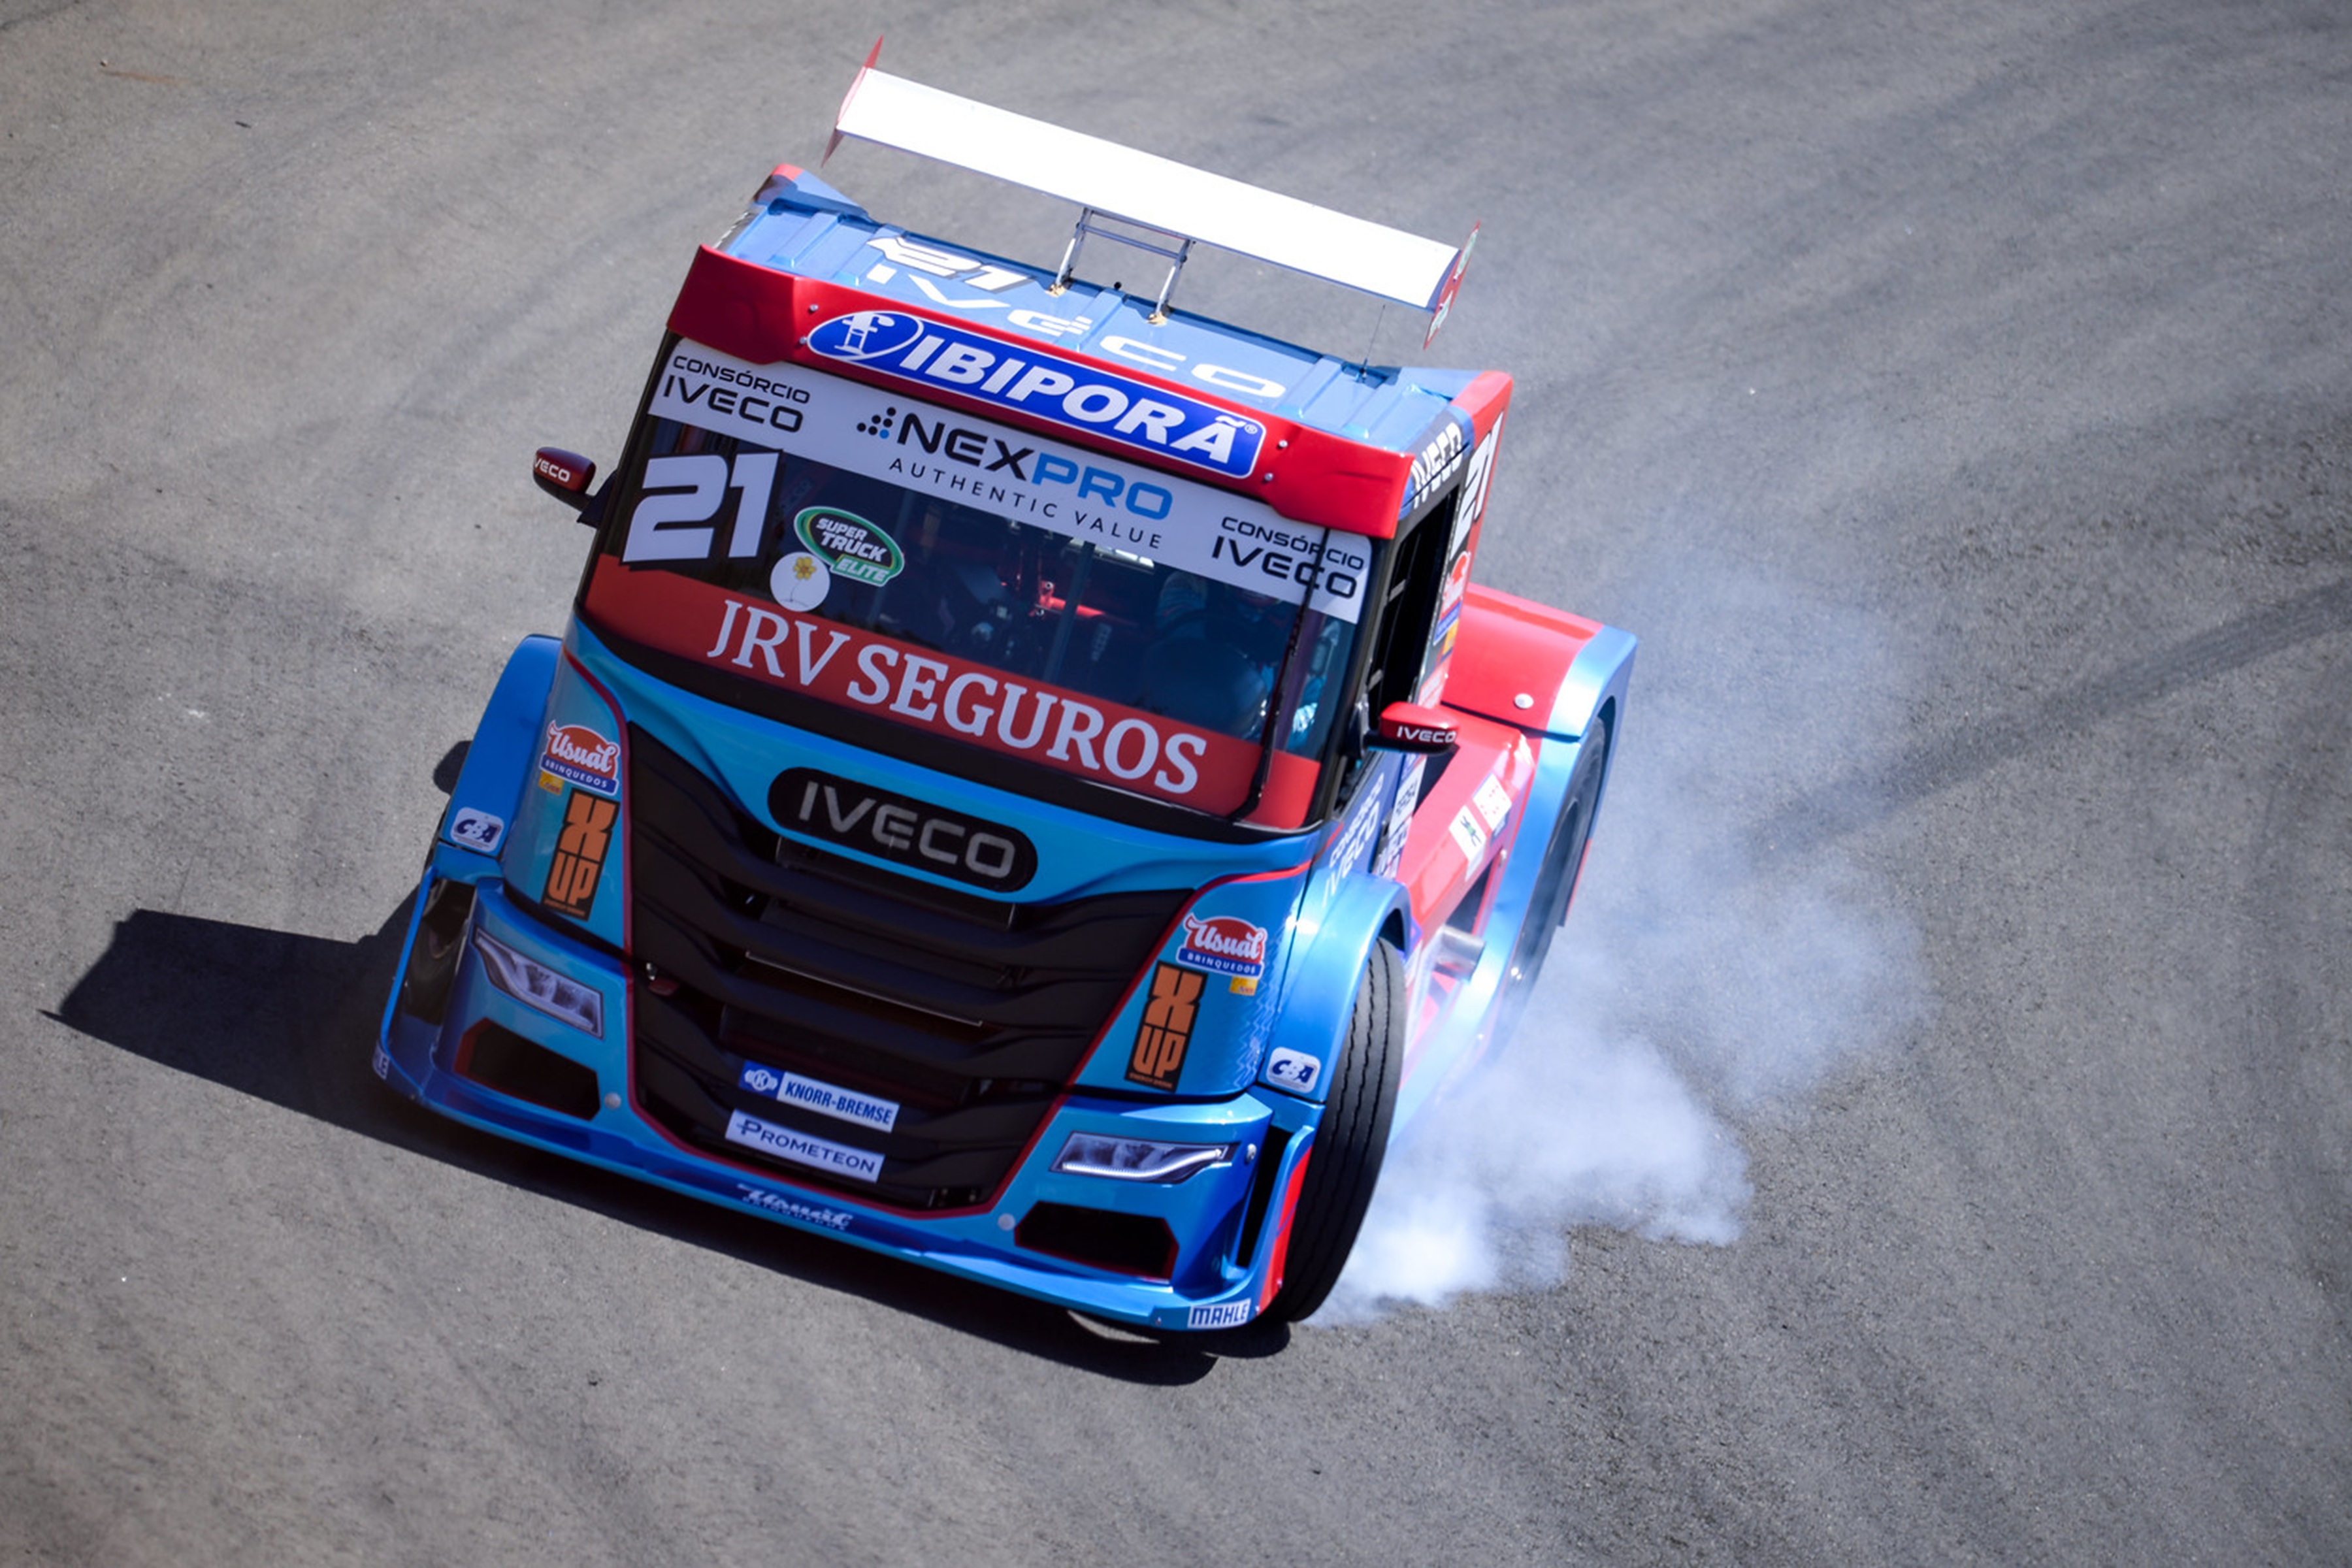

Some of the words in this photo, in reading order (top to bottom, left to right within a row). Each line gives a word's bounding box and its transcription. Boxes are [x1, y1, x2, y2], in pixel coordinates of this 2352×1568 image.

[672, 355, 811, 405] CONSÓRCIO
[663, 374, 804, 433] IVECO
[896, 413, 1173, 521] NEXPRO
[622, 450, 781, 563] 21
[889, 457, 1058, 519] AUTHENTIC
[1074, 510, 1163, 549] VALUE
[815, 517, 868, 540] SUPER
[821, 531, 887, 563] TRUCK
[1221, 516, 1365, 571] CONSÓRCIO
[836, 557, 890, 582] ELITE
[1211, 536, 1358, 599] IVECO
[707, 599, 851, 687] JRV
[846, 644, 1207, 794] SEGUROS
[549, 727, 619, 774] Usual
[1397, 725, 1457, 743] IVECO
[544, 759, 608, 789] BRINQUEDOS
[456, 818, 499, 844] CBA
[797, 780, 1015, 879] IVECO
[1185, 919, 1264, 959] Usual
[1186, 952, 1256, 975] BRINQUEDOS
[1271, 1059, 1315, 1083] CBA
[784, 1081, 893, 1126] KNORR-BREMSE
[1191, 1303, 1247, 1325] MAHLE
